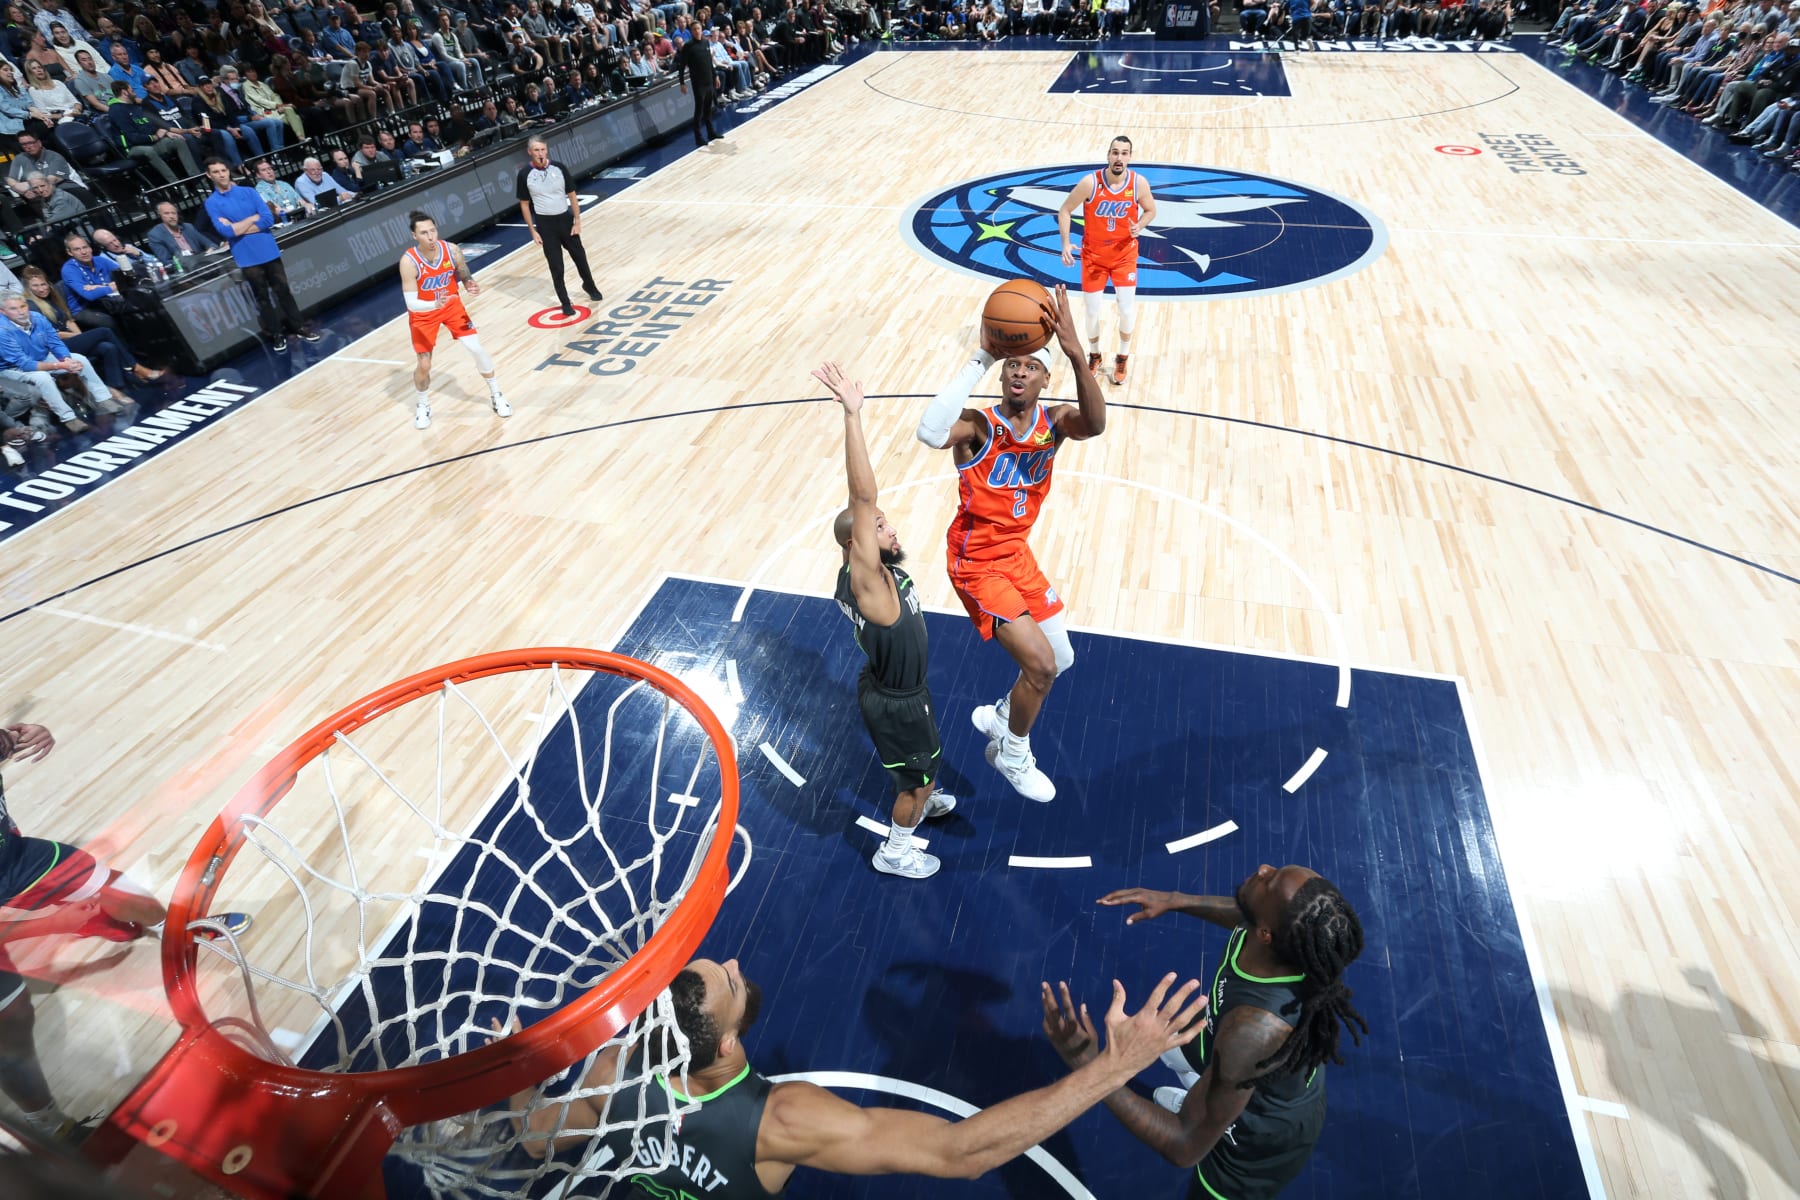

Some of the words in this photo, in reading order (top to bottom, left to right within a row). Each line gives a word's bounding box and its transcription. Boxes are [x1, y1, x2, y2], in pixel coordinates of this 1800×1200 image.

[1477, 132, 1545, 174] TARGET
[1515, 133, 1588, 176] CENTER
[1095, 200, 1132, 218] OKC
[1107, 217, 1116, 232] 9
[289, 271, 328, 296] Google
[421, 270, 454, 291] OKC
[533, 276, 685, 371] TARGET
[588, 278, 734, 376] CENTER
[0, 379, 258, 512] TOURNAMENT
[987, 446, 1055, 489] OKC
[1013, 489, 1028, 518] 2
[636, 1136, 728, 1192] GOBERT
